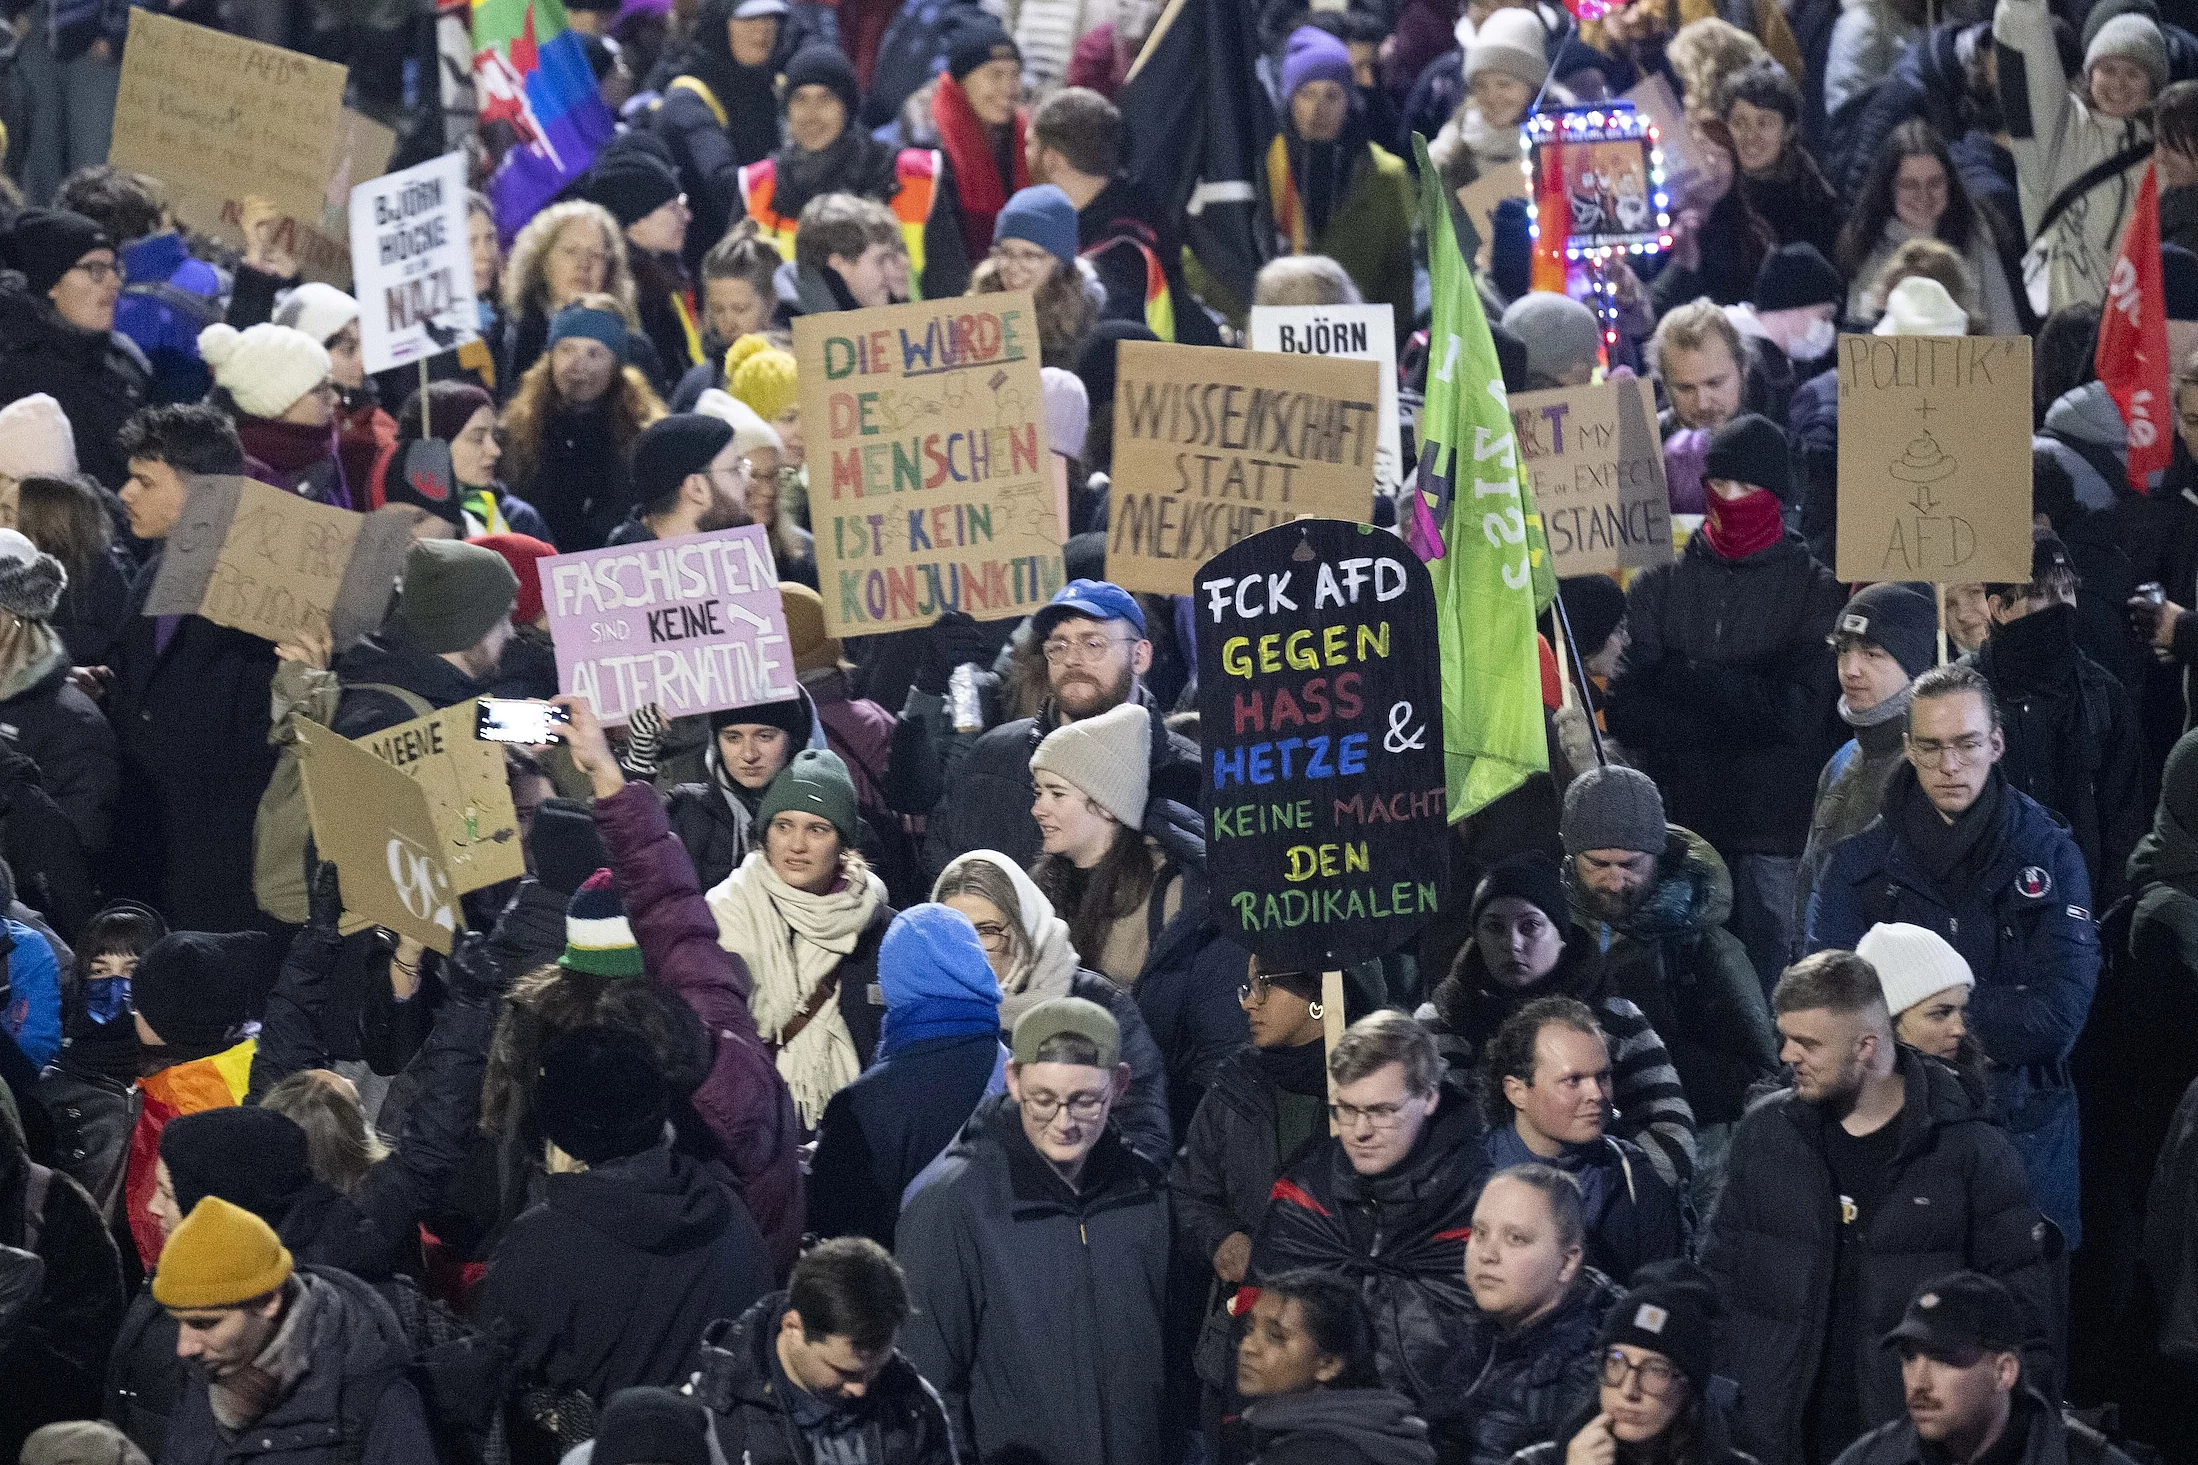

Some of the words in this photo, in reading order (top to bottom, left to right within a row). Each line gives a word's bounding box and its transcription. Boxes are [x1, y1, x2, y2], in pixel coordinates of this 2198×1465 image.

[824, 330, 890, 380] DIE
[899, 310, 1026, 370] WÜRDE
[1279, 317, 1368, 354] BJÖRN
[829, 389, 901, 440] DES
[1124, 379, 1374, 466] WISSENSCHAFT
[1579, 421, 1616, 451] MY
[832, 422, 1038, 500] MENSCHEN
[1174, 452, 1300, 502] STATT
[834, 514, 884, 560] IST
[908, 503, 993, 552] KEIN
[1882, 515, 1977, 571] AFD
[552, 532, 779, 617] FASCHISTEN
[839, 555, 1063, 624] KONJUNKTIV
[1201, 570, 1298, 623] FCK
[1315, 557, 1407, 609] AFD
[590, 619, 631, 643] SIND
[647, 600, 725, 644] KEINE
[1222, 621, 1390, 680] GEGEN
[572, 634, 797, 721] ALTERNATIVE
[1233, 672, 1364, 735] HASS
[1383, 700, 1426, 753] &
[1213, 732, 1369, 790] HETZE
[1213, 800, 1313, 841] KEINE
[1332, 787, 1446, 828] MACHT
[1284, 840, 1370, 882] DEN
[1230, 881, 1439, 932] RADIKALEN
